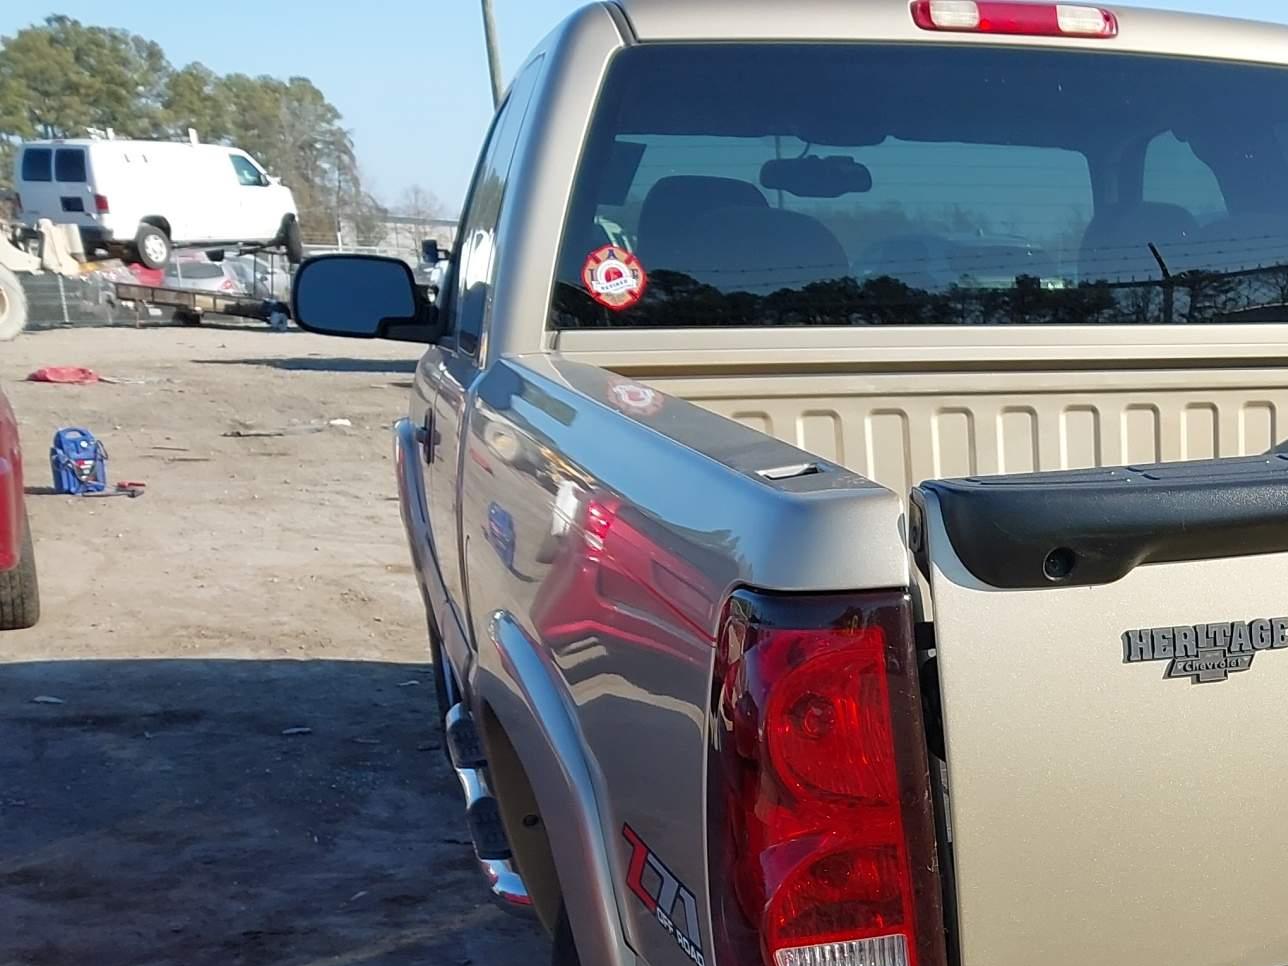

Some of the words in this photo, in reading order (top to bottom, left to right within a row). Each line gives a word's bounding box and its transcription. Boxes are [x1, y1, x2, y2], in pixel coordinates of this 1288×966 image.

[1183, 657, 1243, 673] Chevrolet
[622, 822, 703, 951] Z71
[656, 907, 674, 936] OFF
